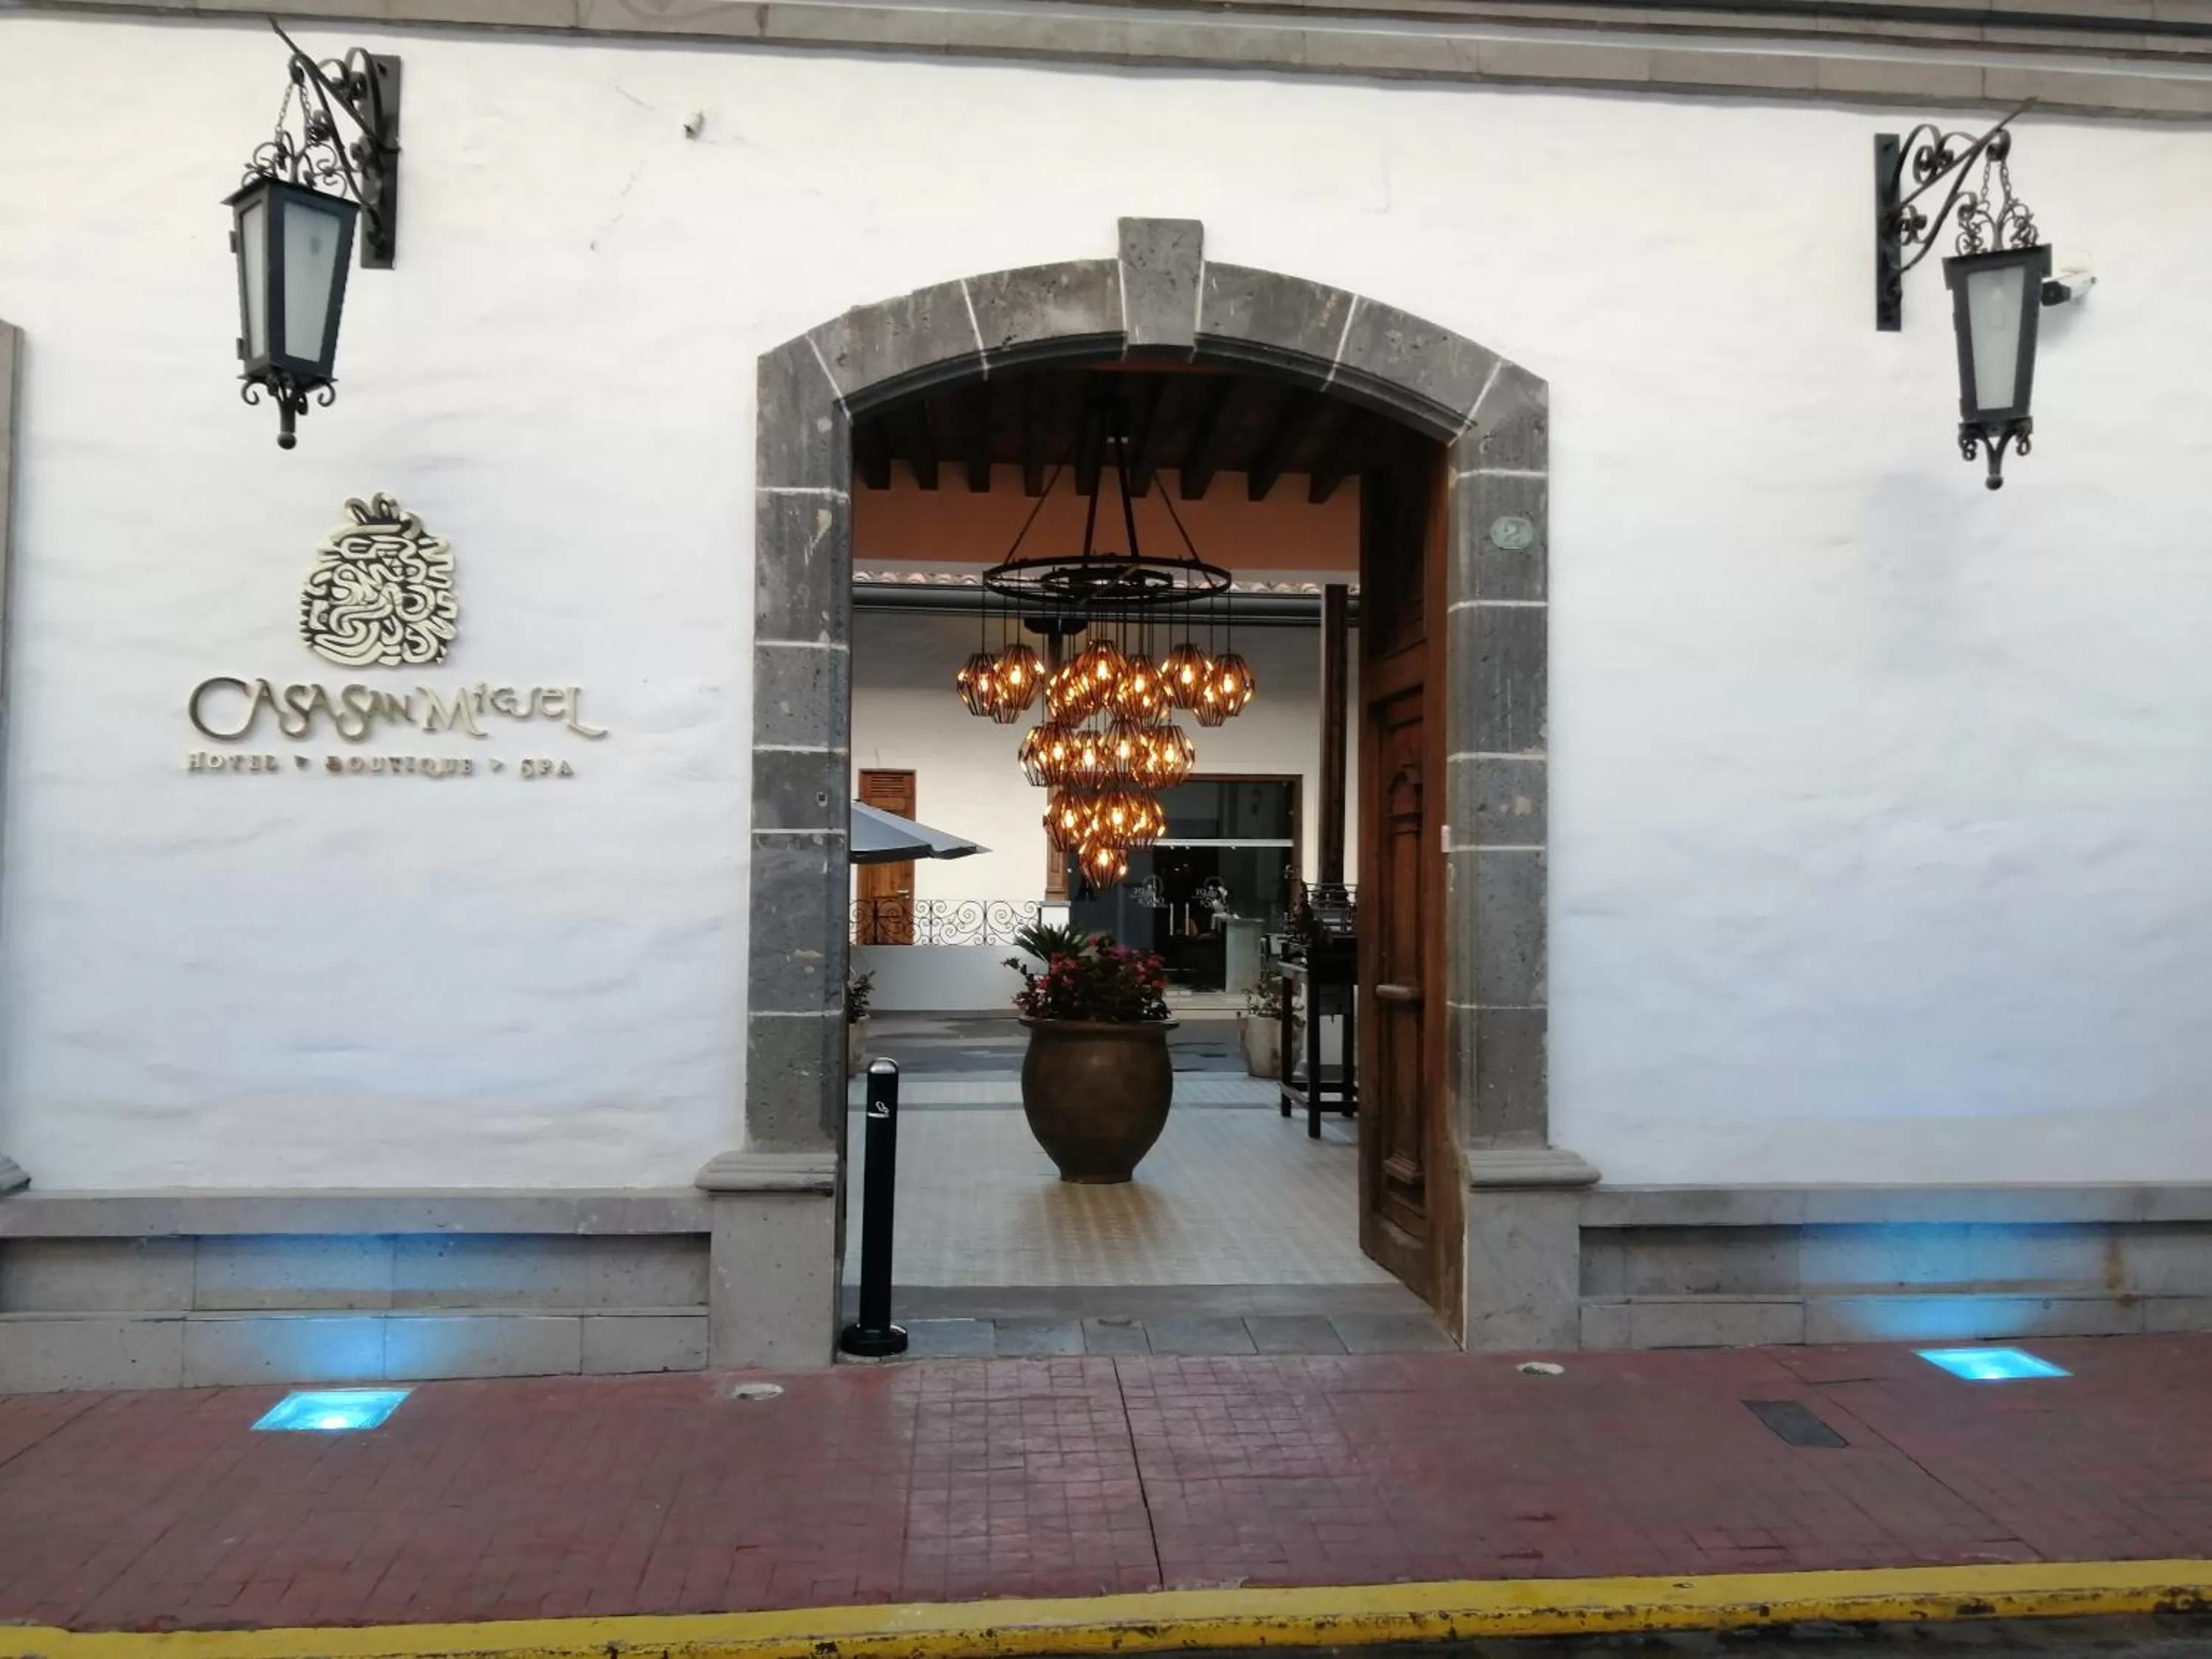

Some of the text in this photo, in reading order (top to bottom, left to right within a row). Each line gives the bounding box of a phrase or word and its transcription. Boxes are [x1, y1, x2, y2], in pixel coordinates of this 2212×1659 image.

[188, 752, 574, 779] HOTEL BOUTIQUE SPA
